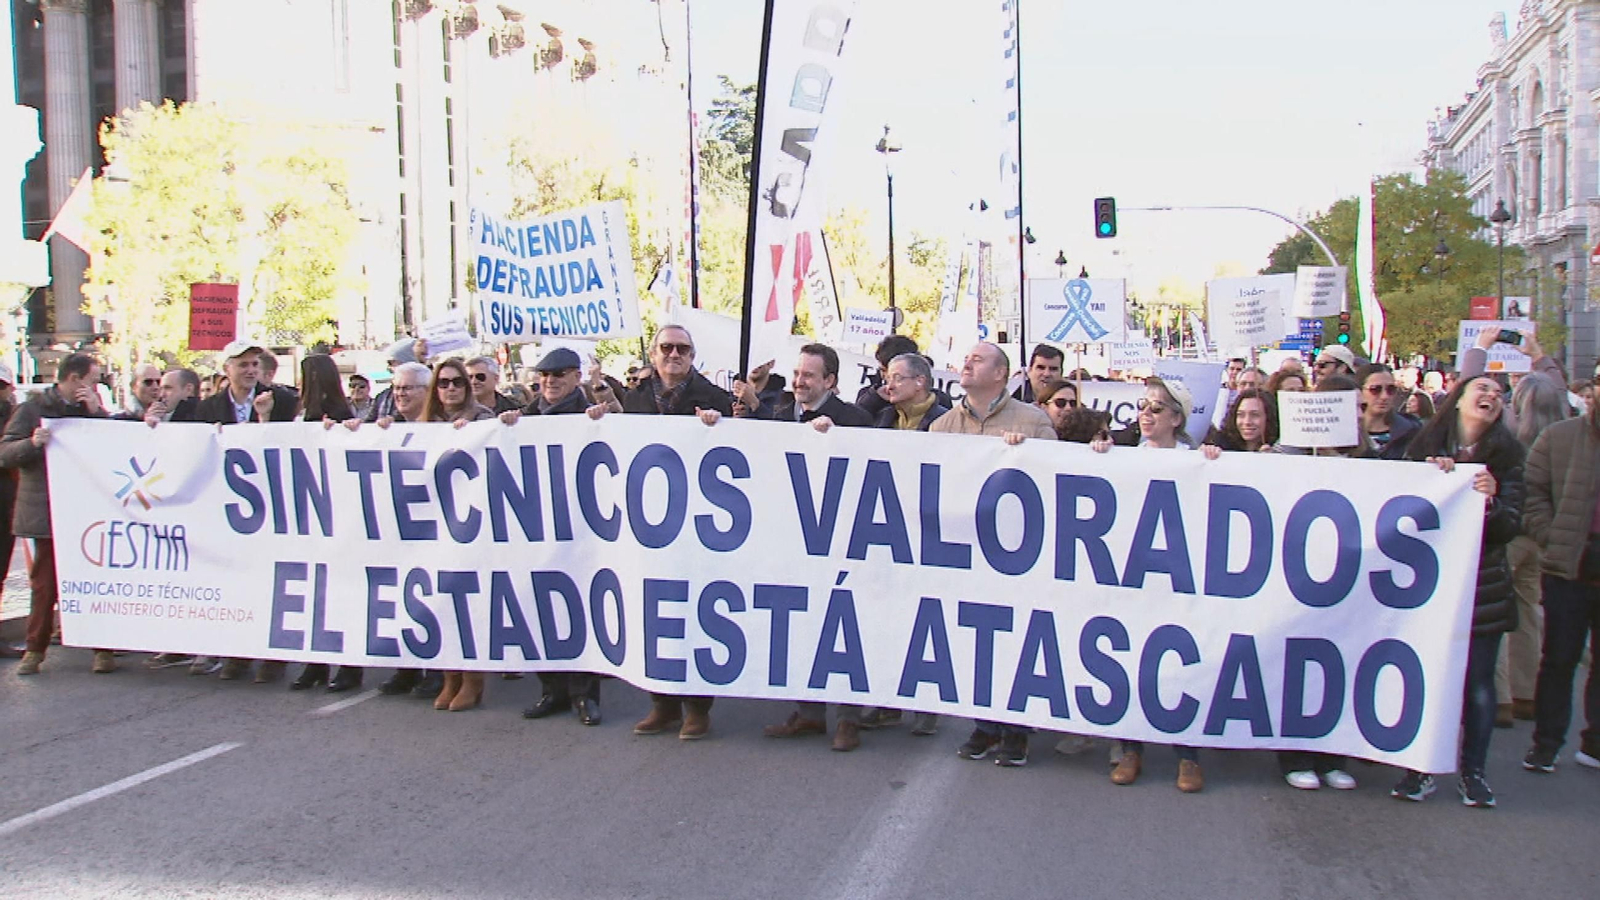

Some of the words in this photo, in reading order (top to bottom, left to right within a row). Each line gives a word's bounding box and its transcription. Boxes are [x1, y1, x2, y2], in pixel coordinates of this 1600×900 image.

[481, 212, 597, 258] HACIENDA
[477, 255, 604, 299] DEFRAUDA
[602, 210, 625, 330] GRANADA
[491, 301, 524, 335] SUS
[527, 299, 610, 336] TECNICOS
[850, 313, 887, 324] Valladolid
[850, 325, 861, 333] 17
[862, 326, 885, 336] años
[224, 447, 333, 538] SIN
[346, 433, 752, 552] TÉCNICOS
[785, 451, 1441, 609] VALORADOS
[81, 520, 190, 572] GESTHA
[61, 580, 133, 598] SINDICATO
[138, 584, 154, 598] DE
[158, 582, 222, 601] TÉCNICOS
[61, 599, 83, 614] DEL
[90, 601, 164, 617] MINISTERIO
[168, 604, 184, 619] DE
[188, 606, 255, 623] HACIENDA
[268, 561, 344, 653] EL
[366, 566, 626, 668] ESTADO
[642, 570, 869, 692] ESTÁ
[896, 597, 1426, 753] ATASCADO
